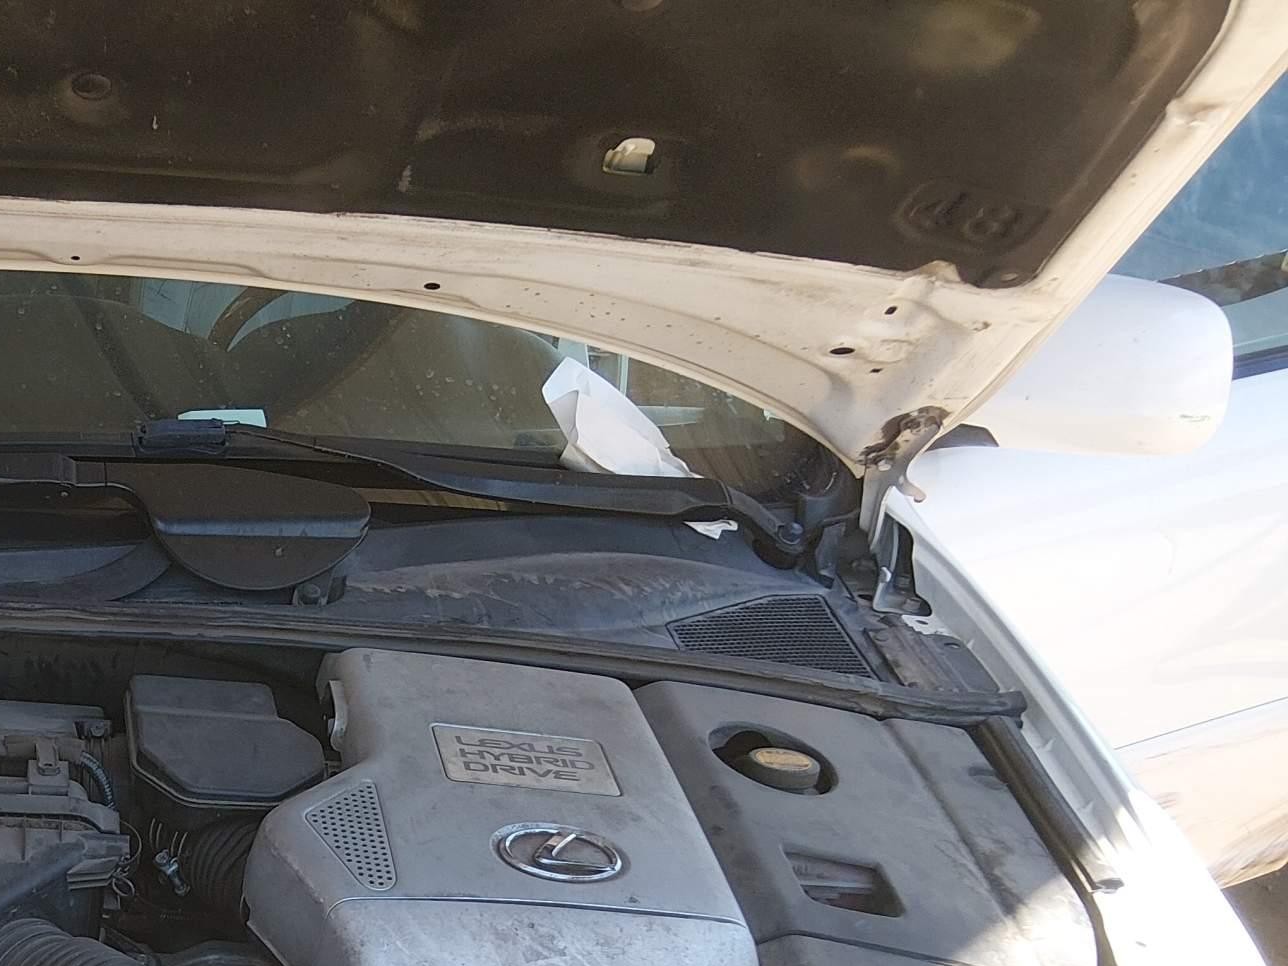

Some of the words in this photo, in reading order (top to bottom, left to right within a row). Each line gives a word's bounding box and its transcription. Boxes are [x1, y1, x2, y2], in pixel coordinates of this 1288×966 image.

[455, 735, 583, 758] LEXUS
[459, 748, 595, 771] HYBRID
[463, 760, 581, 782] DRIVE
